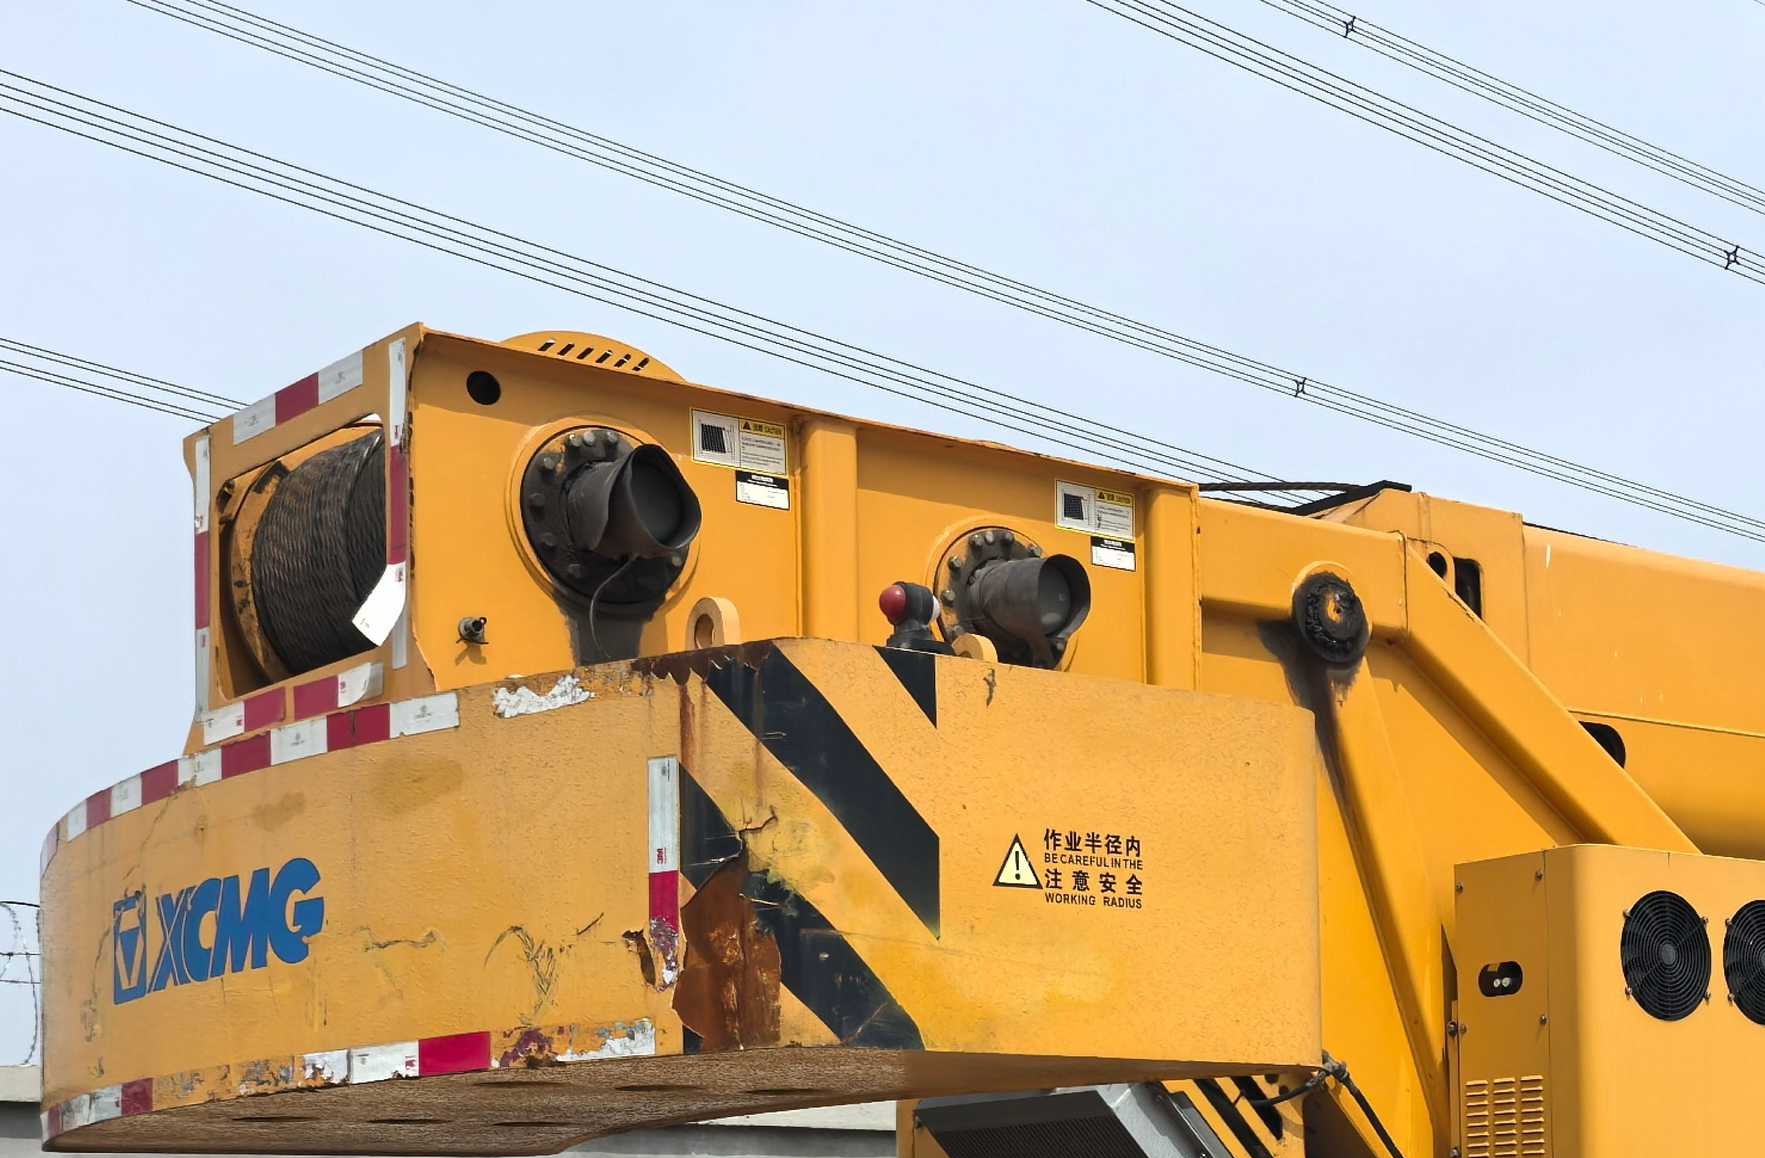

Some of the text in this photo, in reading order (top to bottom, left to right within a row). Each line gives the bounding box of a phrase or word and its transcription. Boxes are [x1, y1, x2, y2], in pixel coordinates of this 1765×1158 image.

[1044, 828, 1141, 857] 作业半径内
[1044, 852, 1143, 871] BE CAREFUL IN THE
[1045, 868, 1143, 896] 注意安全
[1044, 892, 1142, 909] WORKING RADIUS
[148, 858, 324, 994] XCMG
